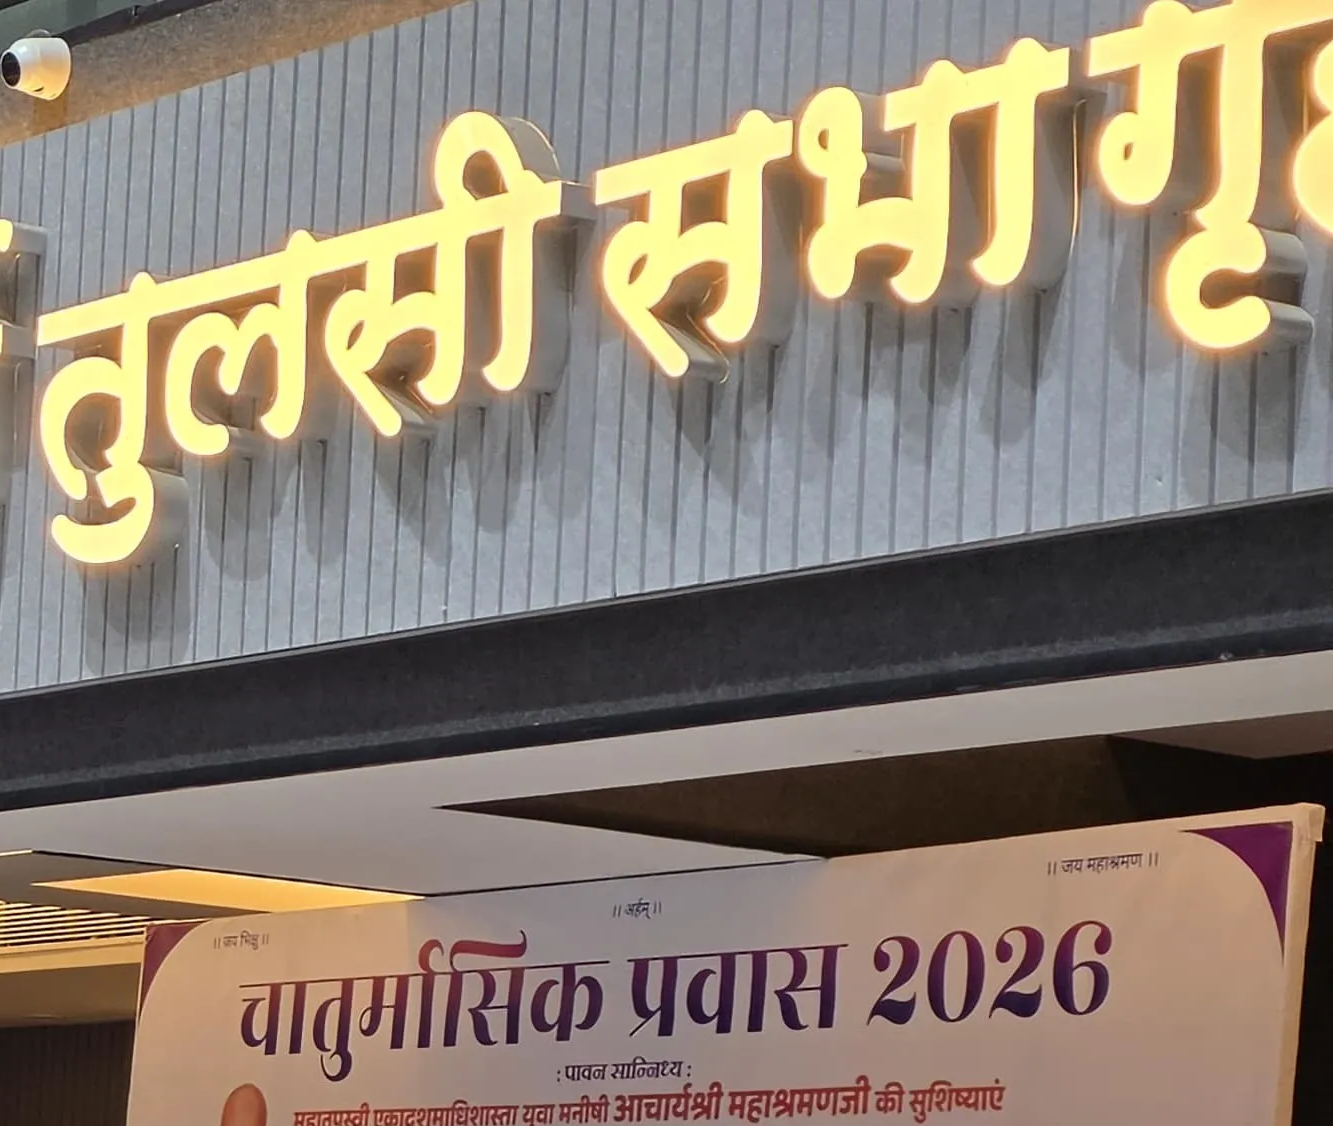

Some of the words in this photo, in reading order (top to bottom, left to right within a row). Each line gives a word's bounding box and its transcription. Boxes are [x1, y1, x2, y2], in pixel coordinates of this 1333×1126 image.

[34, 109, 564, 567] तुलसी
[595, 35, 1073, 381] सभा
[1061, 859, 1084, 874] जय
[1086, 853, 1143, 875] महाश्रमण
[239, 929, 611, 1082] चातुर्मासिक
[627, 943, 849, 1037] प्रवास
[866, 920, 1113, 1027] 2026
[564, 1064, 606, 1082] पावन
[610, 1056, 683, 1081] सान्निध्य
[559, 1096, 610, 1125] मनीषी
[613, 1081, 723, 1123] आचार्यश्री
[728, 1074, 871, 1123] महाश्रमणजी
[874, 1081, 905, 1114] की
[909, 1078, 1005, 1123] सुशिष्याएं
